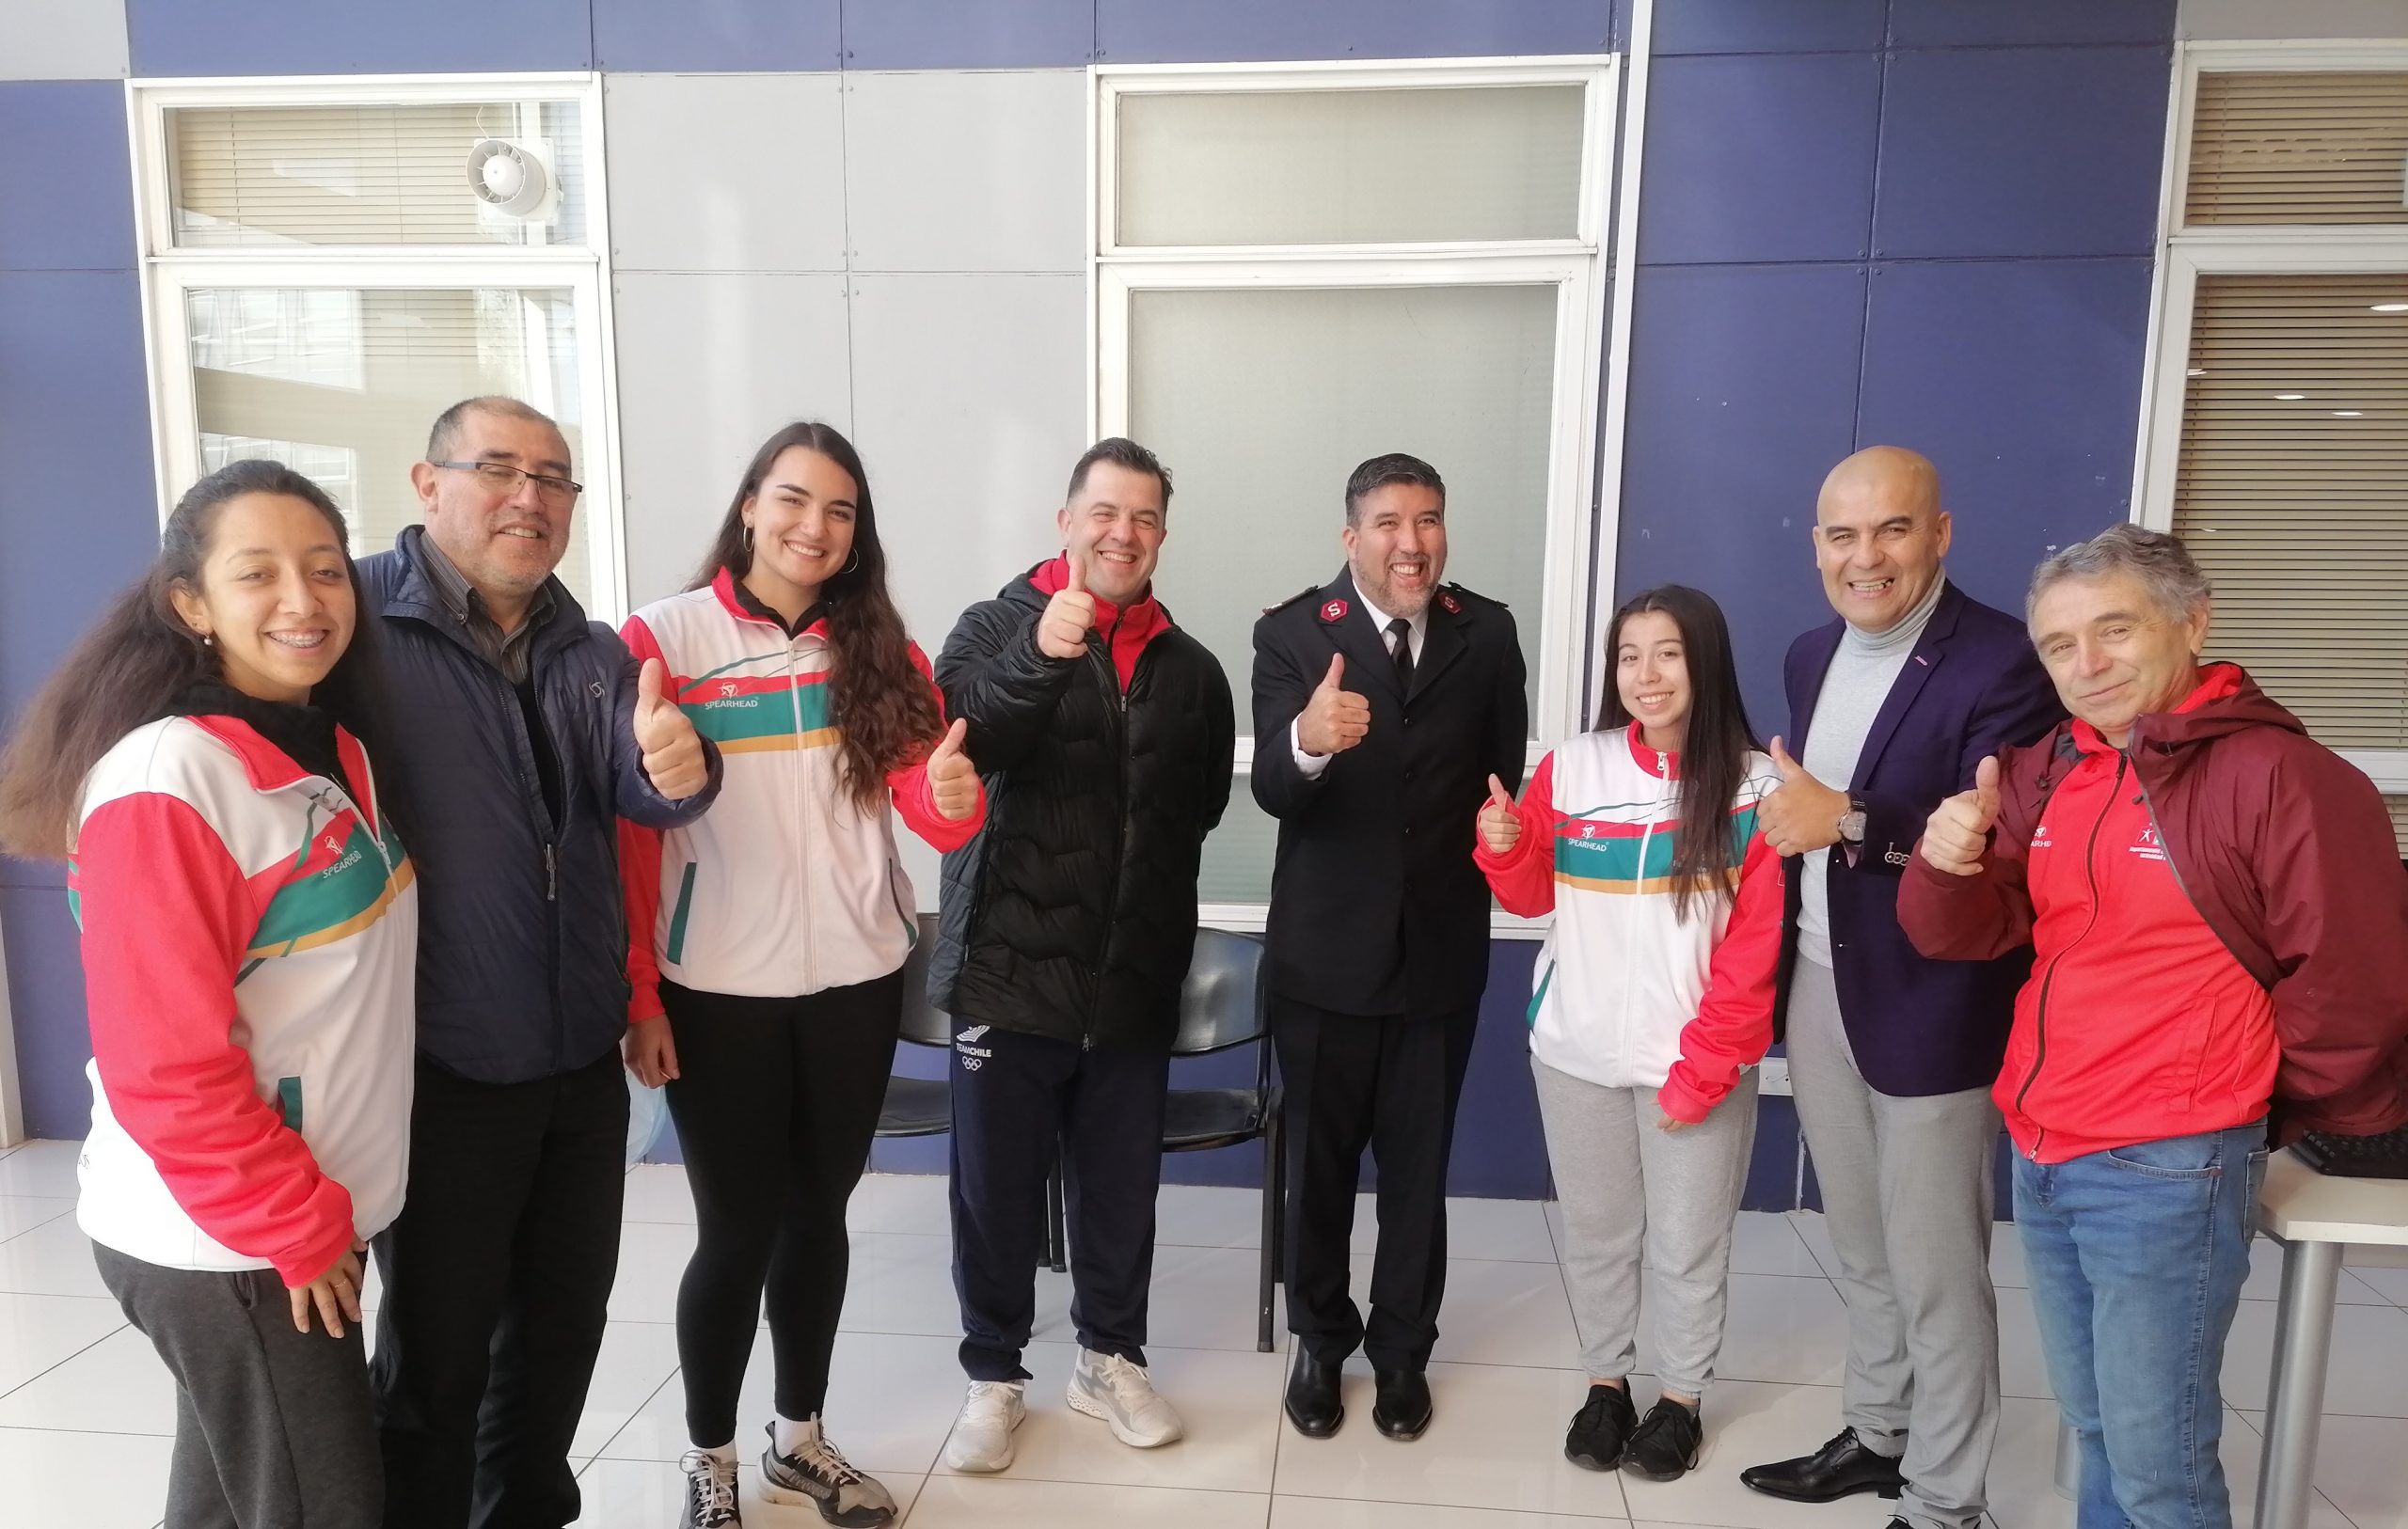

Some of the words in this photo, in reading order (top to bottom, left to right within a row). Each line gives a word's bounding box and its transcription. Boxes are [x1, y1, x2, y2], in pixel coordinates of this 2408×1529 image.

[1327, 602, 1340, 617] S
[705, 700, 759, 710] SPEARHEAD
[1568, 838, 1608, 852] SPEARHEAD
[956, 1042, 992, 1058] TEAMCHILE
